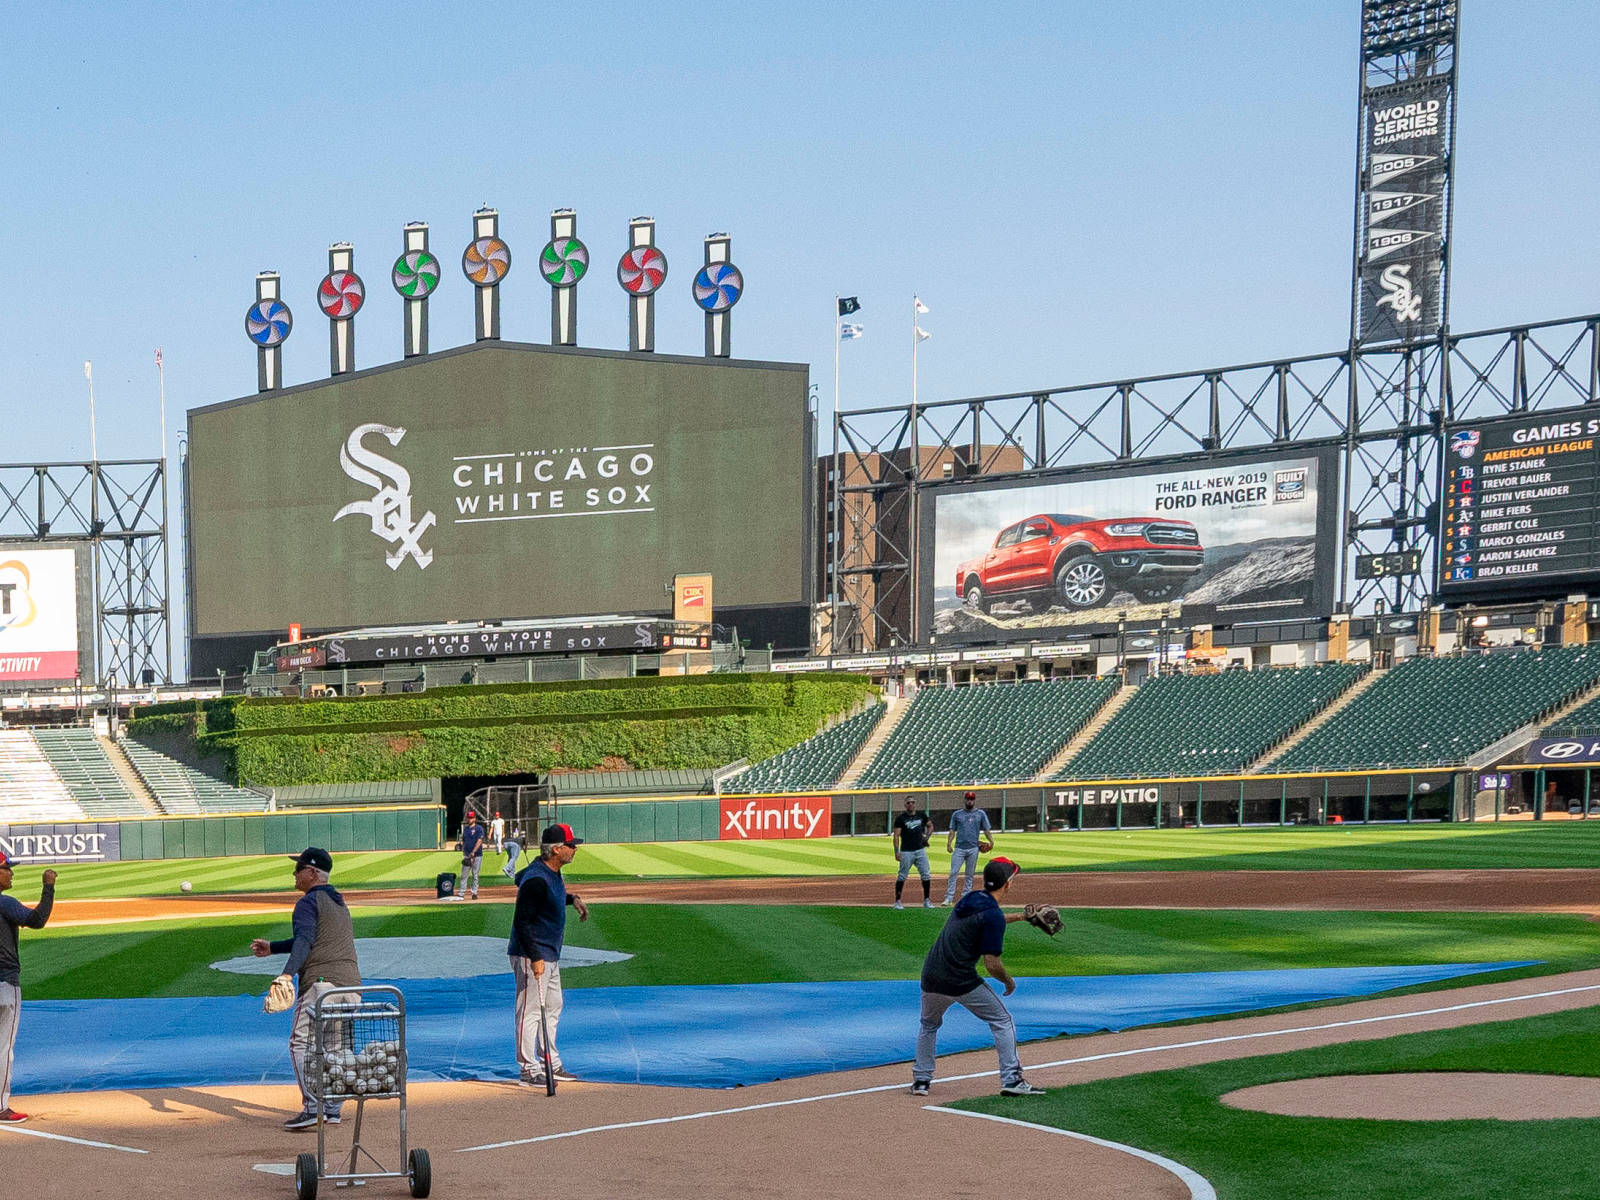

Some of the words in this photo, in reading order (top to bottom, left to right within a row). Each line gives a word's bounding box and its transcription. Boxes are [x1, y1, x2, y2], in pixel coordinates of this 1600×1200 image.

[1373, 100, 1439, 124] WORLD
[1373, 113, 1438, 137] SERIES
[1373, 127, 1438, 146] CHAMPIONS
[1373, 158, 1415, 174] 2005
[1373, 196, 1413, 211] 1917
[1372, 234, 1412, 248] 1906
[1513, 422, 1581, 443] GAMES
[1587, 420, 1600, 434] S
[1483, 447, 1544, 462] AMERICAN
[1547, 440, 1593, 453] LEAGUE
[453, 453, 653, 487] CHICAGO
[1482, 463, 1507, 474] RYNE
[1509, 459, 1546, 470] STANEK
[1156, 482, 1177, 493] THE
[1181, 476, 1234, 491] ALL-NEW
[1238, 472, 1267, 485] 2019
[1276, 471, 1304, 482] BUILT
[1482, 477, 1518, 489] TREVOR
[1520, 473, 1551, 484] BAUER
[456, 490, 564, 514] WHITE
[586, 485, 651, 506] SOX
[1155, 495, 1196, 510] FORD
[1201, 487, 1267, 506] RANGER
[1276, 491, 1304, 500] TOUGH
[1481, 492, 1513, 504] JUSTIN
[1515, 486, 1570, 499] VERLANDER
[1481, 508, 1504, 519] MIKE
[1506, 505, 1532, 515] FIERS
[1480, 521, 1513, 533] GERRIT
[1515, 519, 1538, 529] COLE
[1479, 536, 1514, 548] MARCO
[1516, 531, 1565, 544] GONZALES
[1479, 551, 1513, 563] AARON
[1514, 547, 1557, 559] SANCHEZ
[1478, 567, 1504, 577] BRAD
[1506, 563, 1538, 574] KELLER
[684, 588, 703, 596] CIBC
[428, 636, 470, 644] HOME
[481, 634, 500, 642] OF
[511, 631, 552, 640] YOUR
[375, 645, 469, 658] CHICAGO
[485, 640, 551, 652] WHITE
[568, 637, 606, 648] SOX
[1055, 789, 1095, 806] THE
[1100, 788, 1158, 804] PATIO
[725, 801, 824, 838] xfinity
